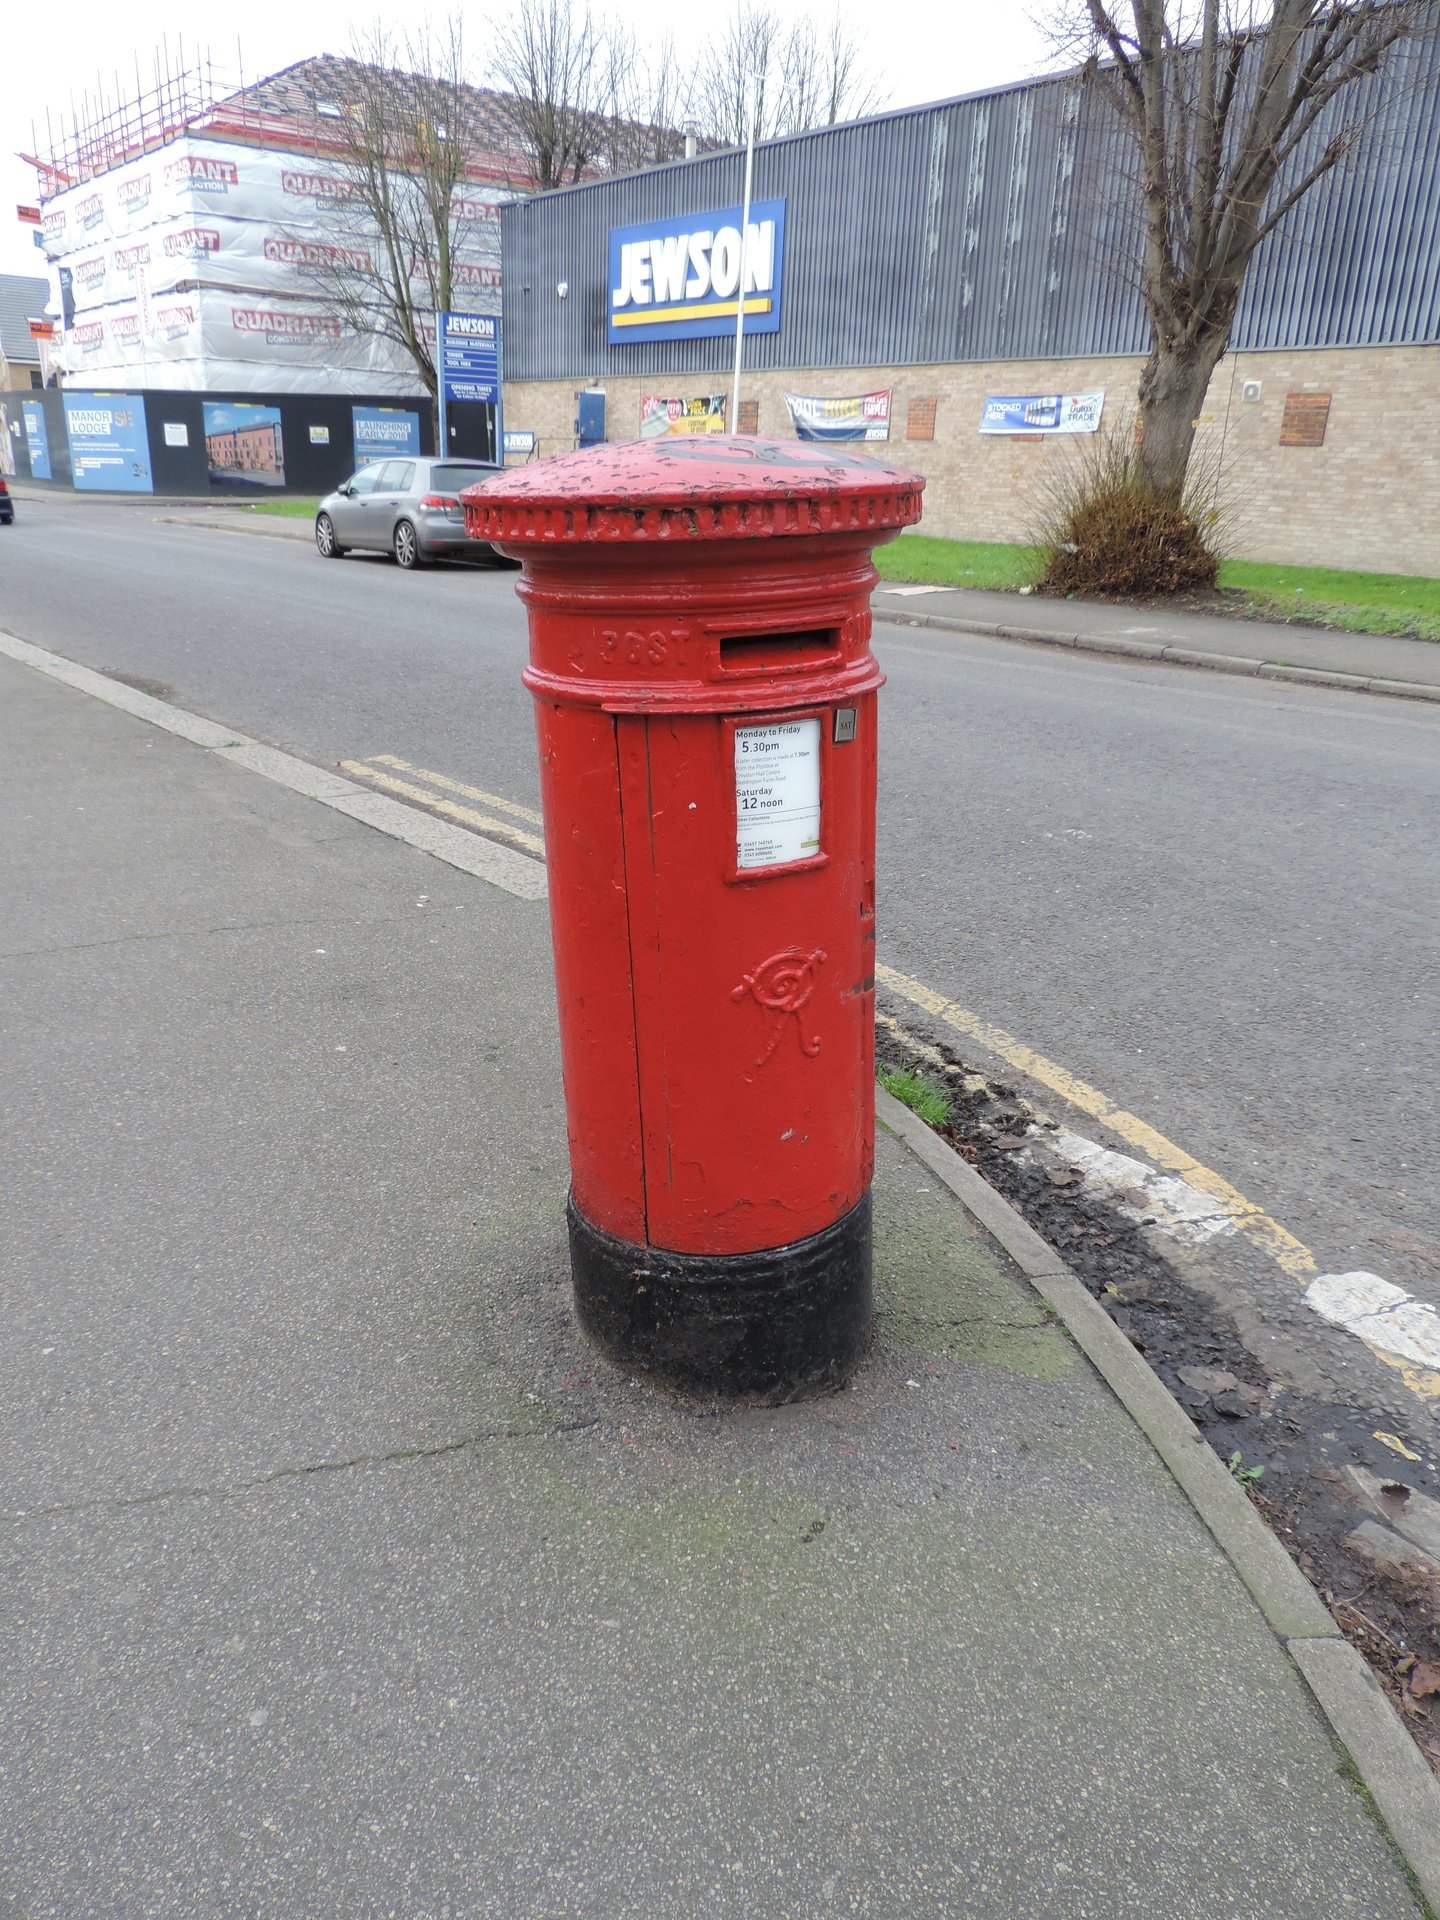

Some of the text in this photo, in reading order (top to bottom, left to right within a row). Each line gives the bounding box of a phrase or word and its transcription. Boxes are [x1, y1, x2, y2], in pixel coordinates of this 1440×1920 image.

[613, 220, 775, 307] JEWSON
[447, 316, 495, 336] JEWSON
[470, 341, 495, 349] MATERIALS
[788, 398, 820, 417] TOOL
[986, 403, 1022, 413] STOCKED
[71, 411, 110, 422] MANOR
[985, 412, 1006, 420] HERE
[1068, 413, 1095, 421] TRADE
[73, 422, 109, 433] LODGE
[358, 422, 409, 431] LAUNCHING
[359, 430, 385, 439] EARLY
[508, 434, 533, 448] JEWSON
[840, 721, 852, 731] SAT
[736, 729, 768, 739] Monday
[778, 726, 801, 735] Friday
[742, 740, 780, 753] 5.30pm
[736, 788, 772, 797] Saturday
[742, 797, 783, 810] 12 noon
